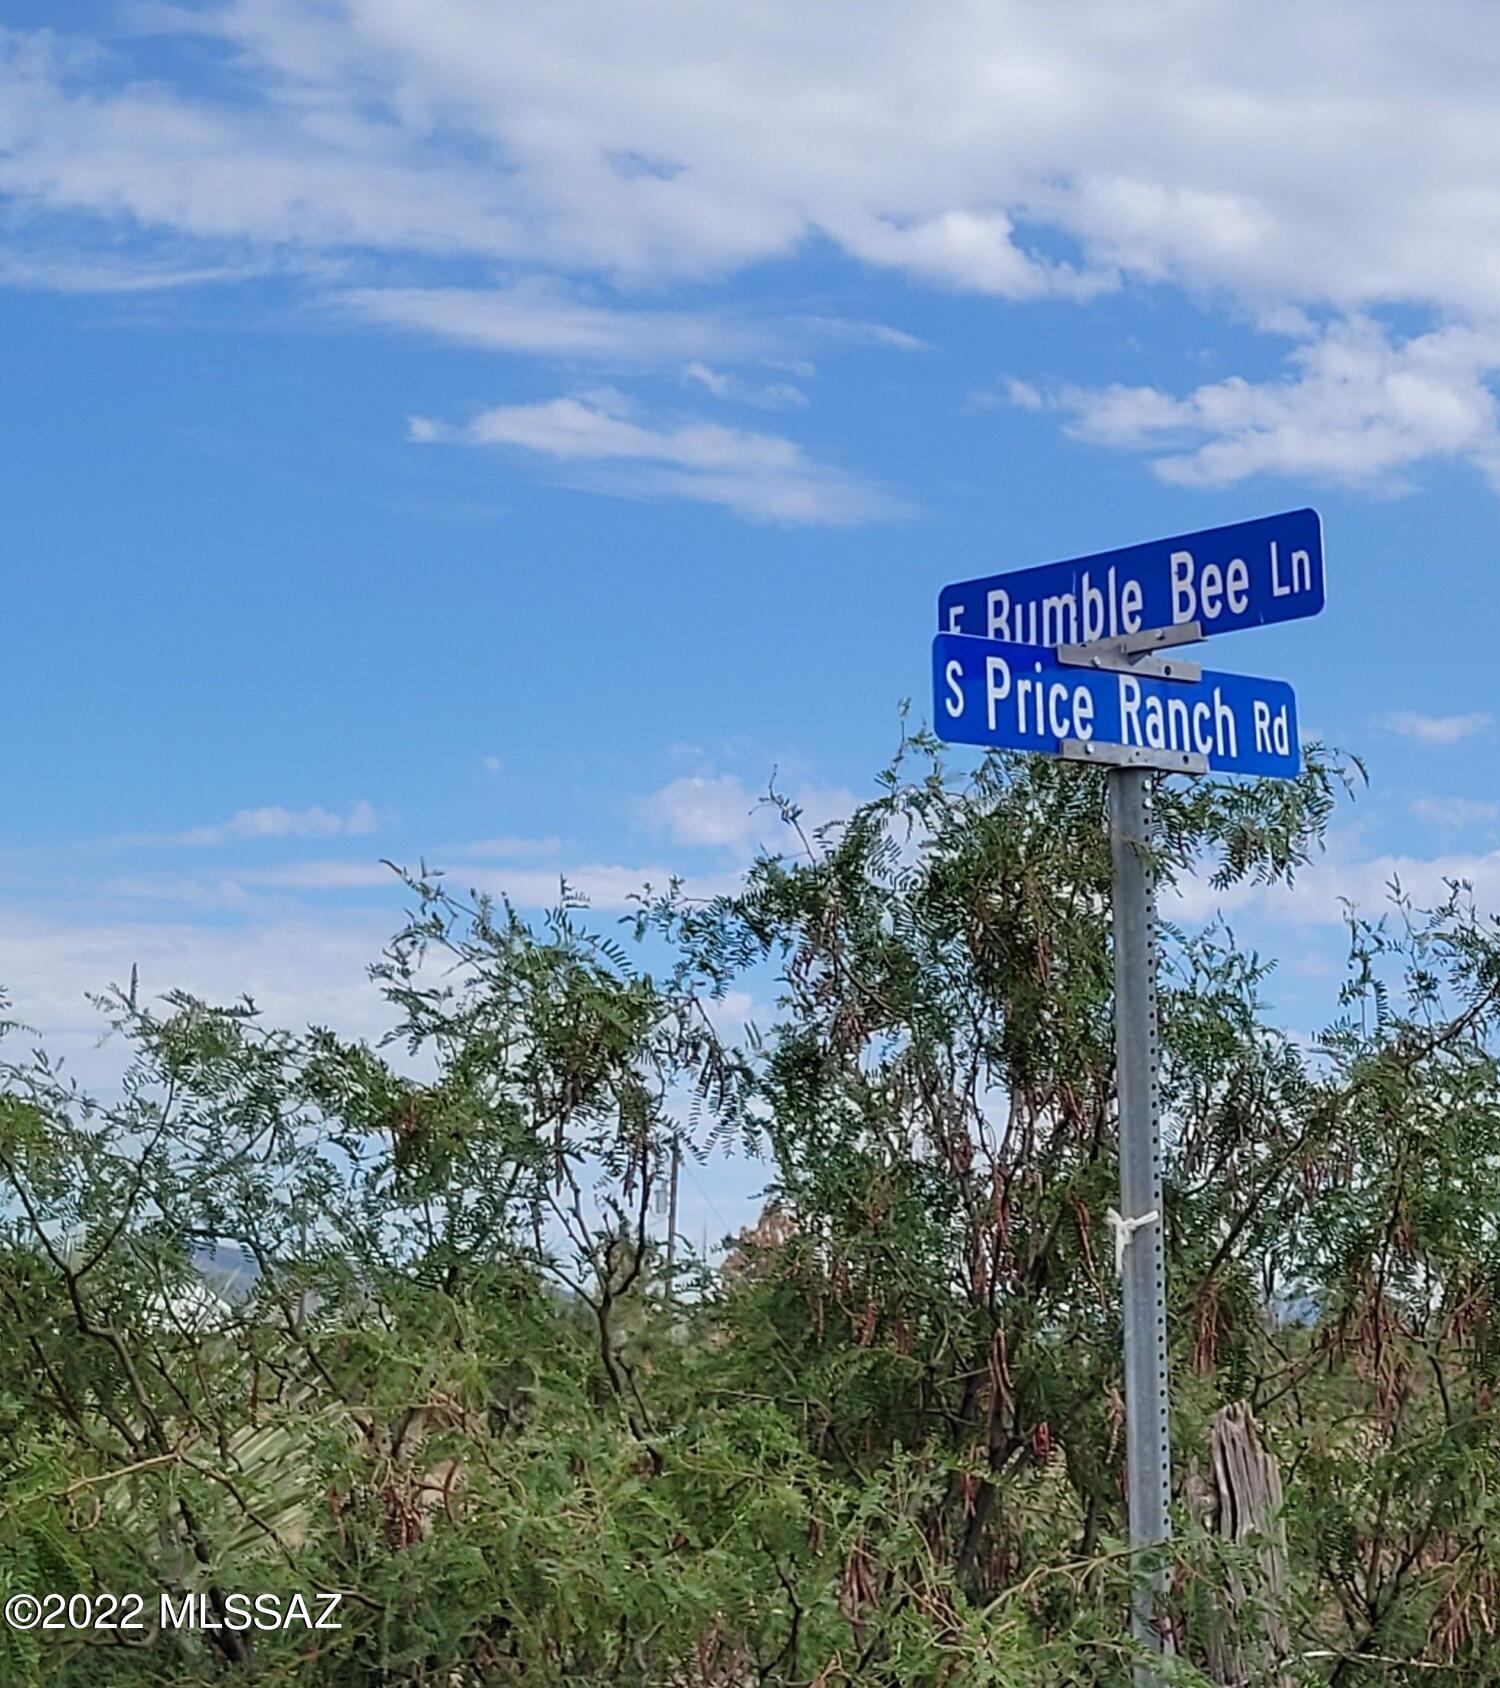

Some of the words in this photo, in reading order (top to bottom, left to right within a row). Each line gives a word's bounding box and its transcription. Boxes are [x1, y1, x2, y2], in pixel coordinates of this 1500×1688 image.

[986, 565, 1144, 648] Bumble
[1169, 550, 1250, 625] Bee
[1270, 540, 1312, 598] Ln
[945, 659, 965, 718] S
[986, 655, 1095, 741] Price
[1118, 673, 1239, 759] Ranch
[1252, 699, 1290, 757] Rd
